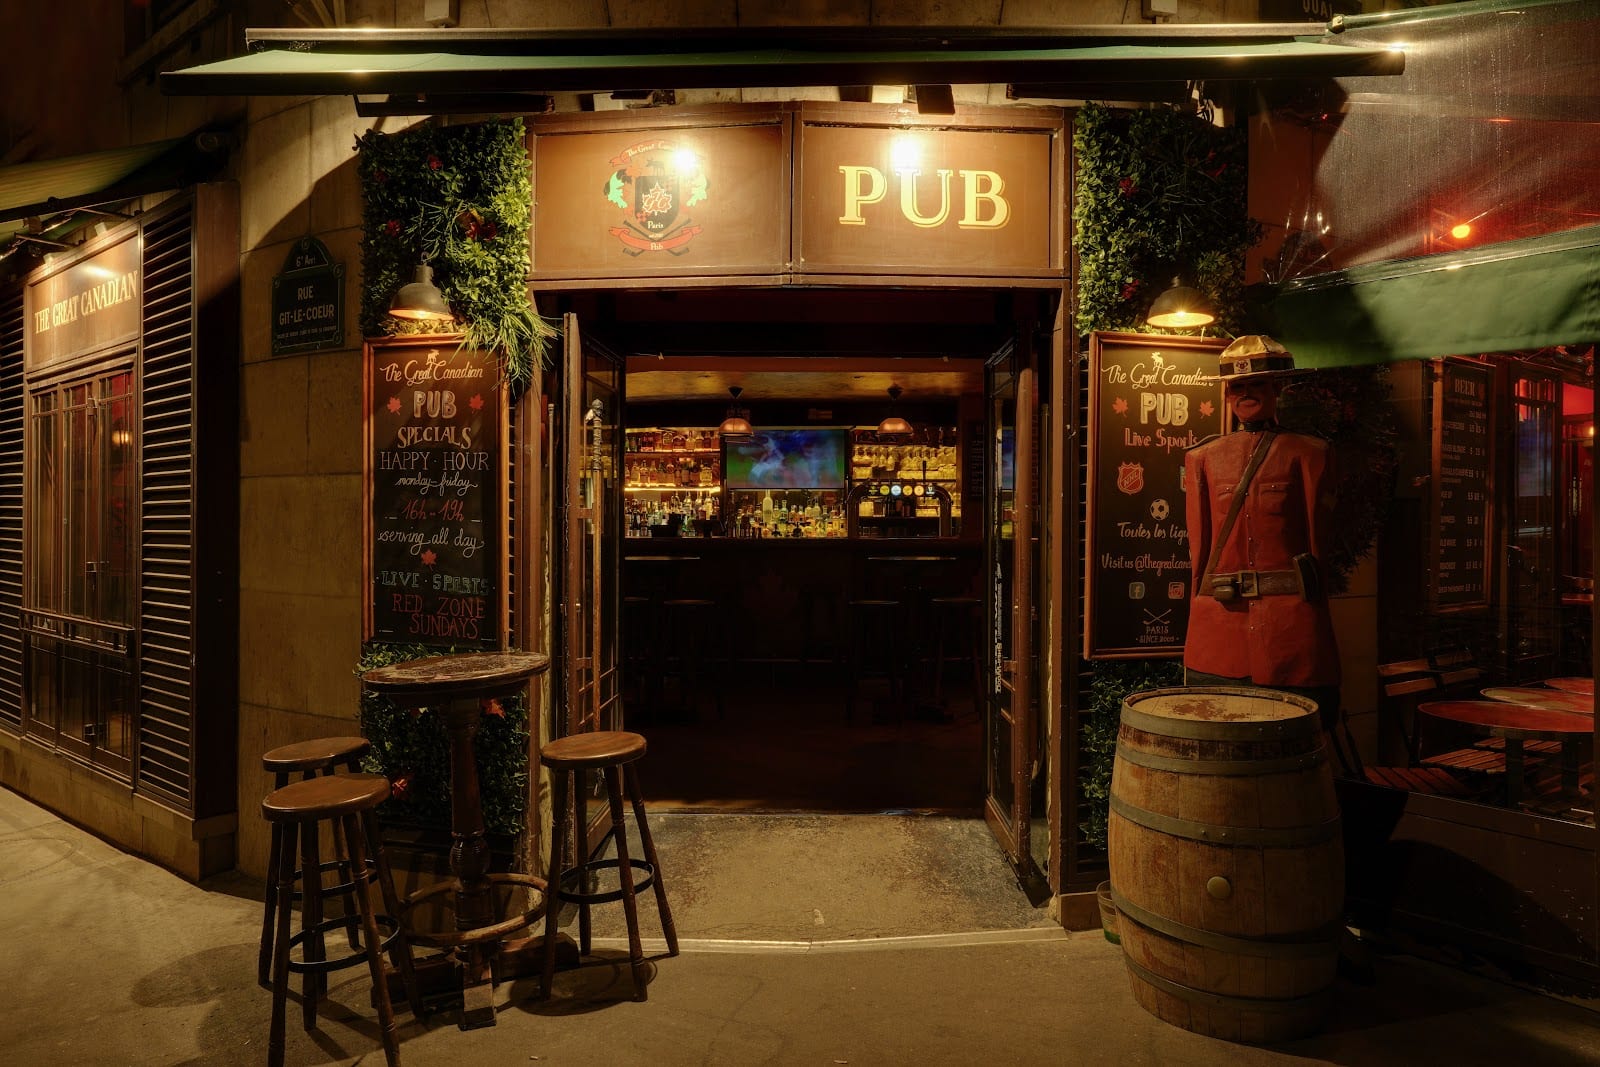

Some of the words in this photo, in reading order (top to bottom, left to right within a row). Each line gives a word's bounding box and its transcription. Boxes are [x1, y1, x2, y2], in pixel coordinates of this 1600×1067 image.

[838, 165, 1012, 230] PUB
[647, 220, 664, 229] Paris
[35, 307, 49, 334] THE
[53, 295, 79, 327] GREAT
[81, 270, 138, 316] CANADIAN
[297, 285, 314, 301] RUE
[379, 363, 402, 382] The
[404, 360, 433, 386] Great
[433, 360, 483, 381] Canadian
[1101, 364, 1127, 383] The
[1130, 363, 1160, 389] Great
[413, 390, 457, 419] PUB
[1140, 392, 1189, 426] PUB
[397, 426, 472, 450] SPECIALS
[1124, 427, 1152, 447] Live
[1156, 428, 1199, 455] Sports
[379, 451, 431, 470] HAPPY
[442, 451, 490, 470] HOUR
[377, 526, 431, 556] serving
[431, 527, 450, 545] all
[453, 528, 485, 558] day
[1117, 521, 1151, 538] Toutes
[1101, 552, 1124, 568] Visit
[380, 570, 420, 588] LIVE
[433, 574, 488, 595] SPORTS
[392, 593, 423, 613] RED
[436, 596, 486, 619] ZONE
[409, 613, 479, 640] SUNDAYS
[1138, 634, 1159, 643] SINCE
[1145, 625, 1169, 634] PARIS
